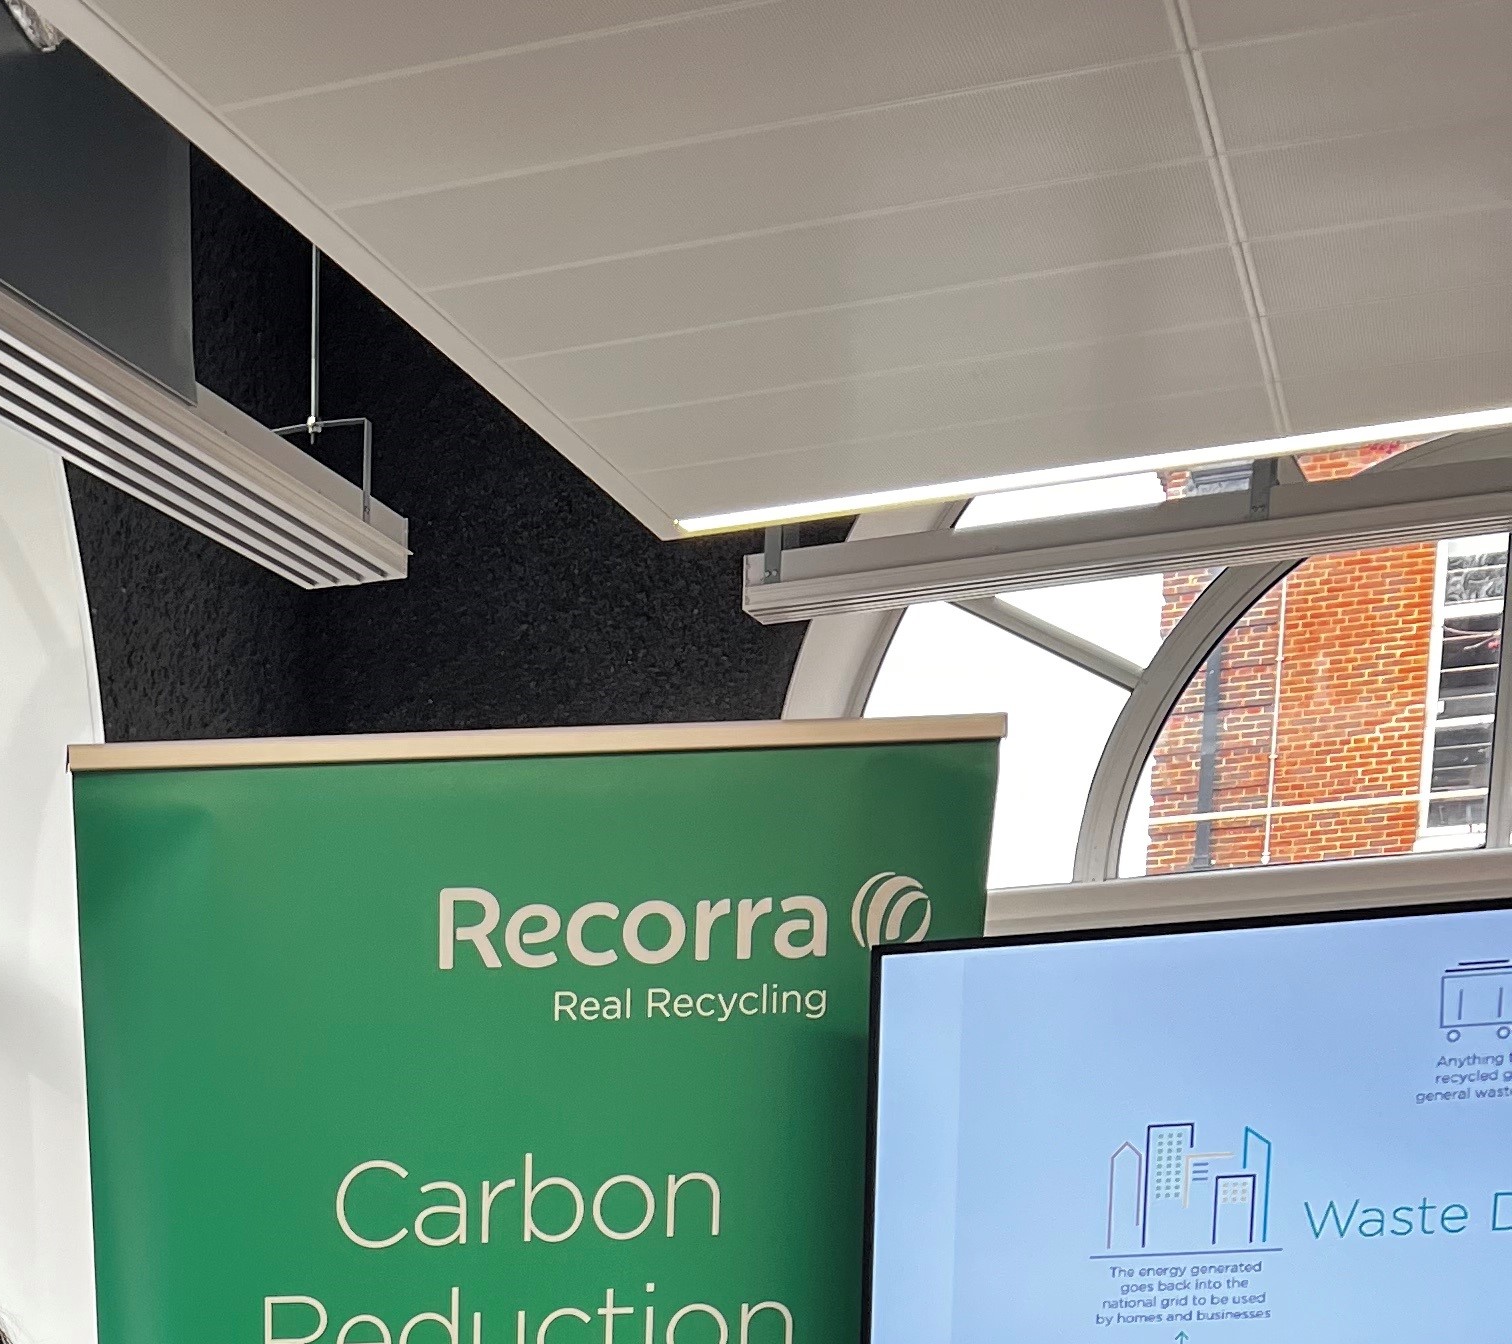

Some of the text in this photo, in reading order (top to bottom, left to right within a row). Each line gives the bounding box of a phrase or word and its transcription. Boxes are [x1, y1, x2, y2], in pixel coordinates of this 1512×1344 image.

[439, 886, 829, 970] Recorra
[554, 983, 829, 1022] Real Recycling
[1436, 1052, 1505, 1069] Anything
[1435, 1069, 1499, 1085] recycled
[1416, 1086, 1512, 1105] general wast
[336, 1152, 723, 1250] Carbon
[1304, 1196, 1470, 1240] Waste
[1109, 1260, 1263, 1279] The energy generated
[1120, 1276, 1250, 1296] goes back into the
[1102, 1291, 1267, 1310] national grid to be used
[1095, 1308, 1272, 1328] by homes and businesses
